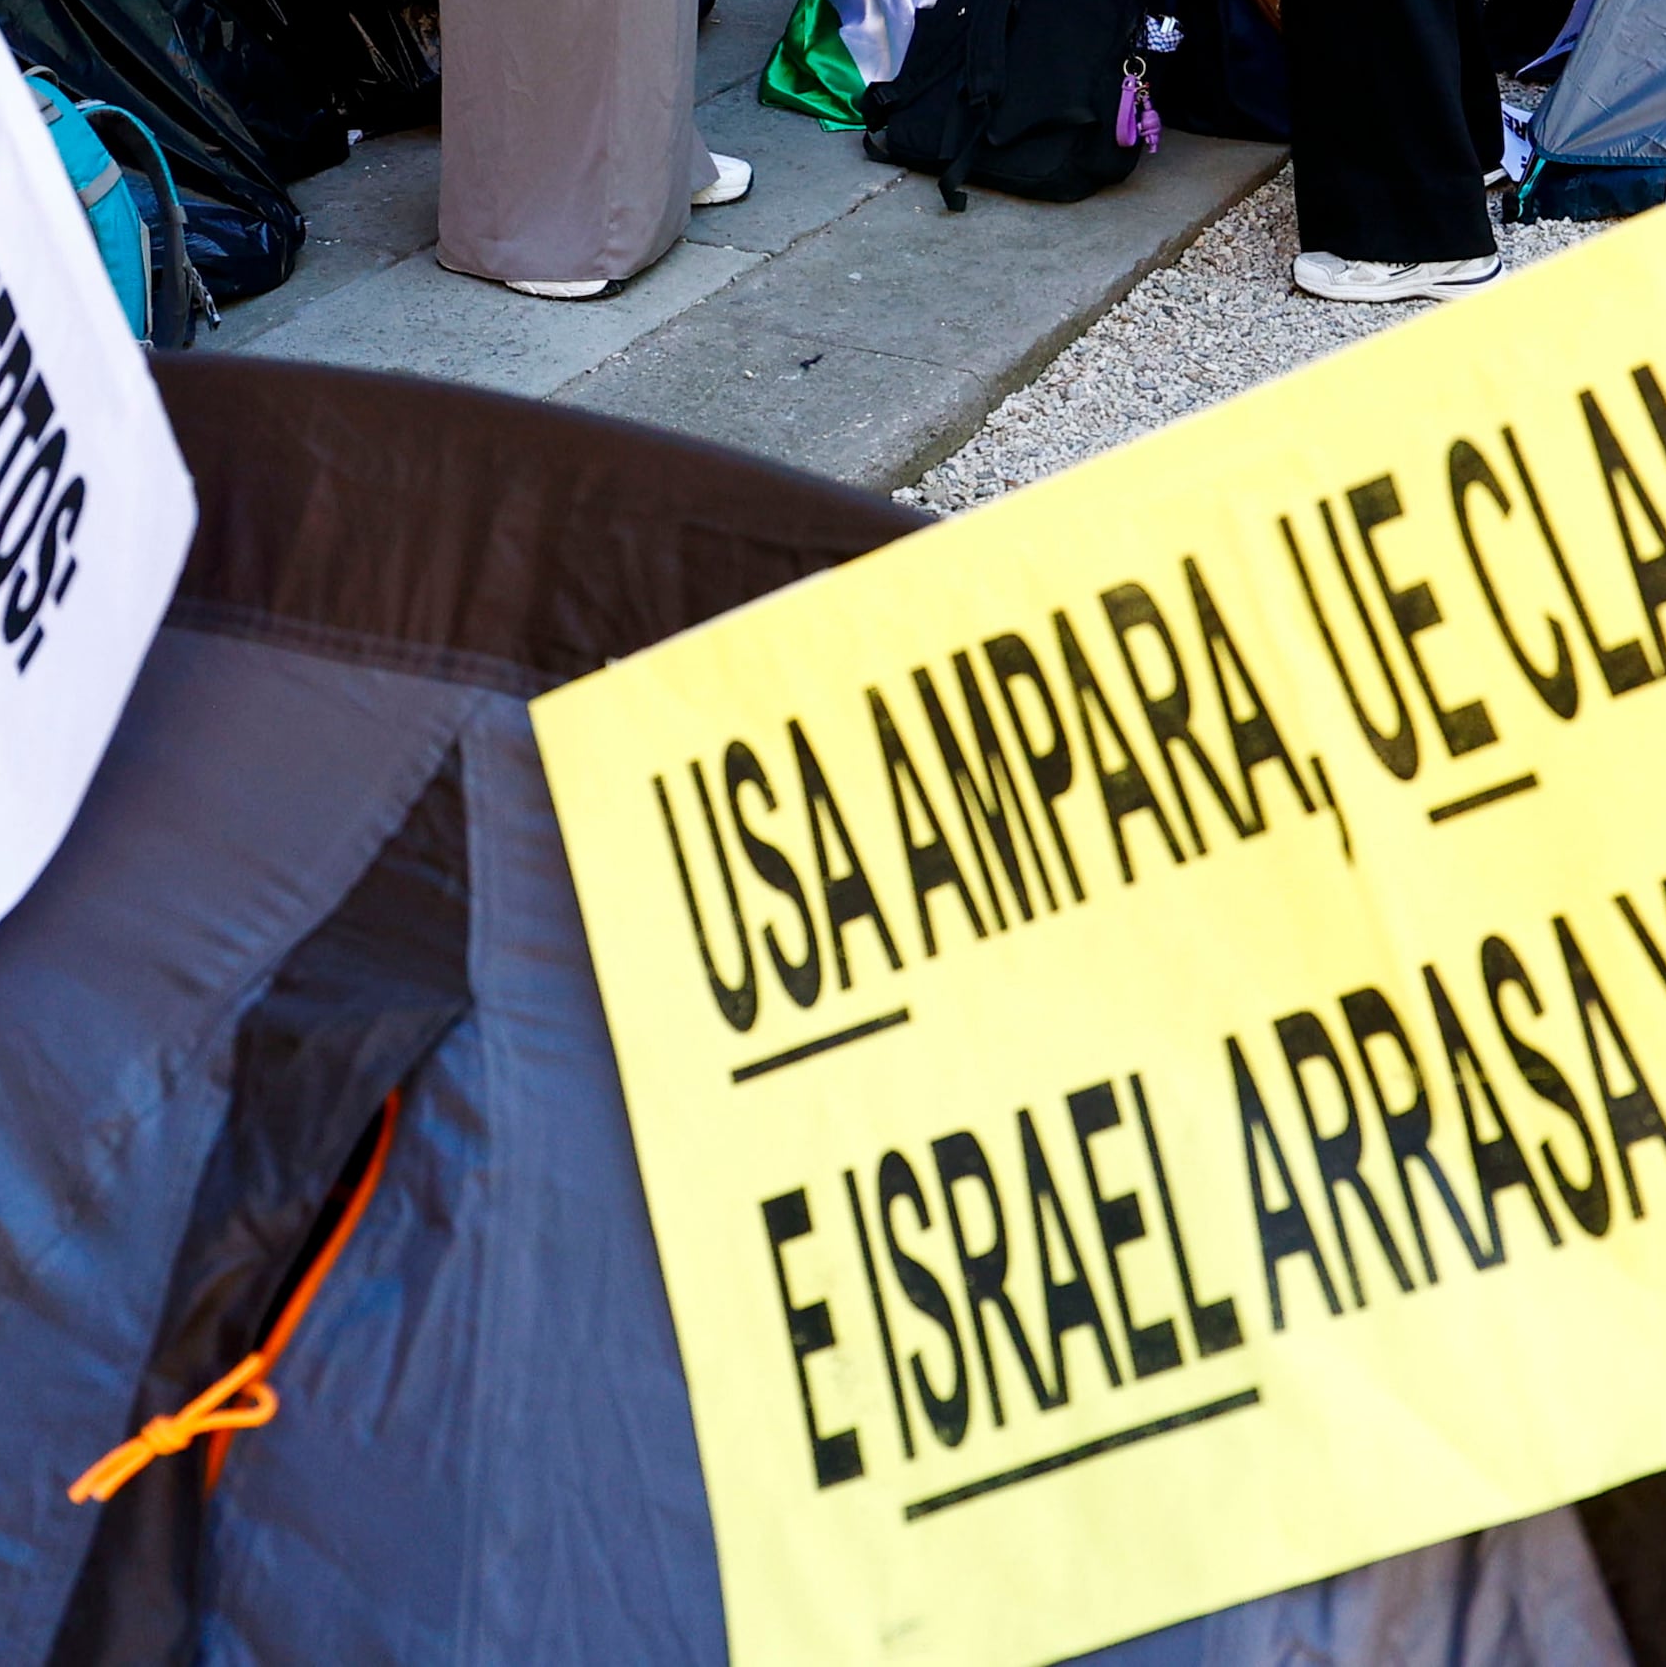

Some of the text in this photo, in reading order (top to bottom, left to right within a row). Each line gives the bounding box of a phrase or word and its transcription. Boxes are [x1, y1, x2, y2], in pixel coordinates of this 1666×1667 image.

[651, 716, 906, 1035] USA
[863, 555, 1355, 865] AMPARA,
[1276, 471, 1502, 784] UE
[758, 1186, 866, 1491] E
[841, 1071, 1249, 1463] ISRAEL
